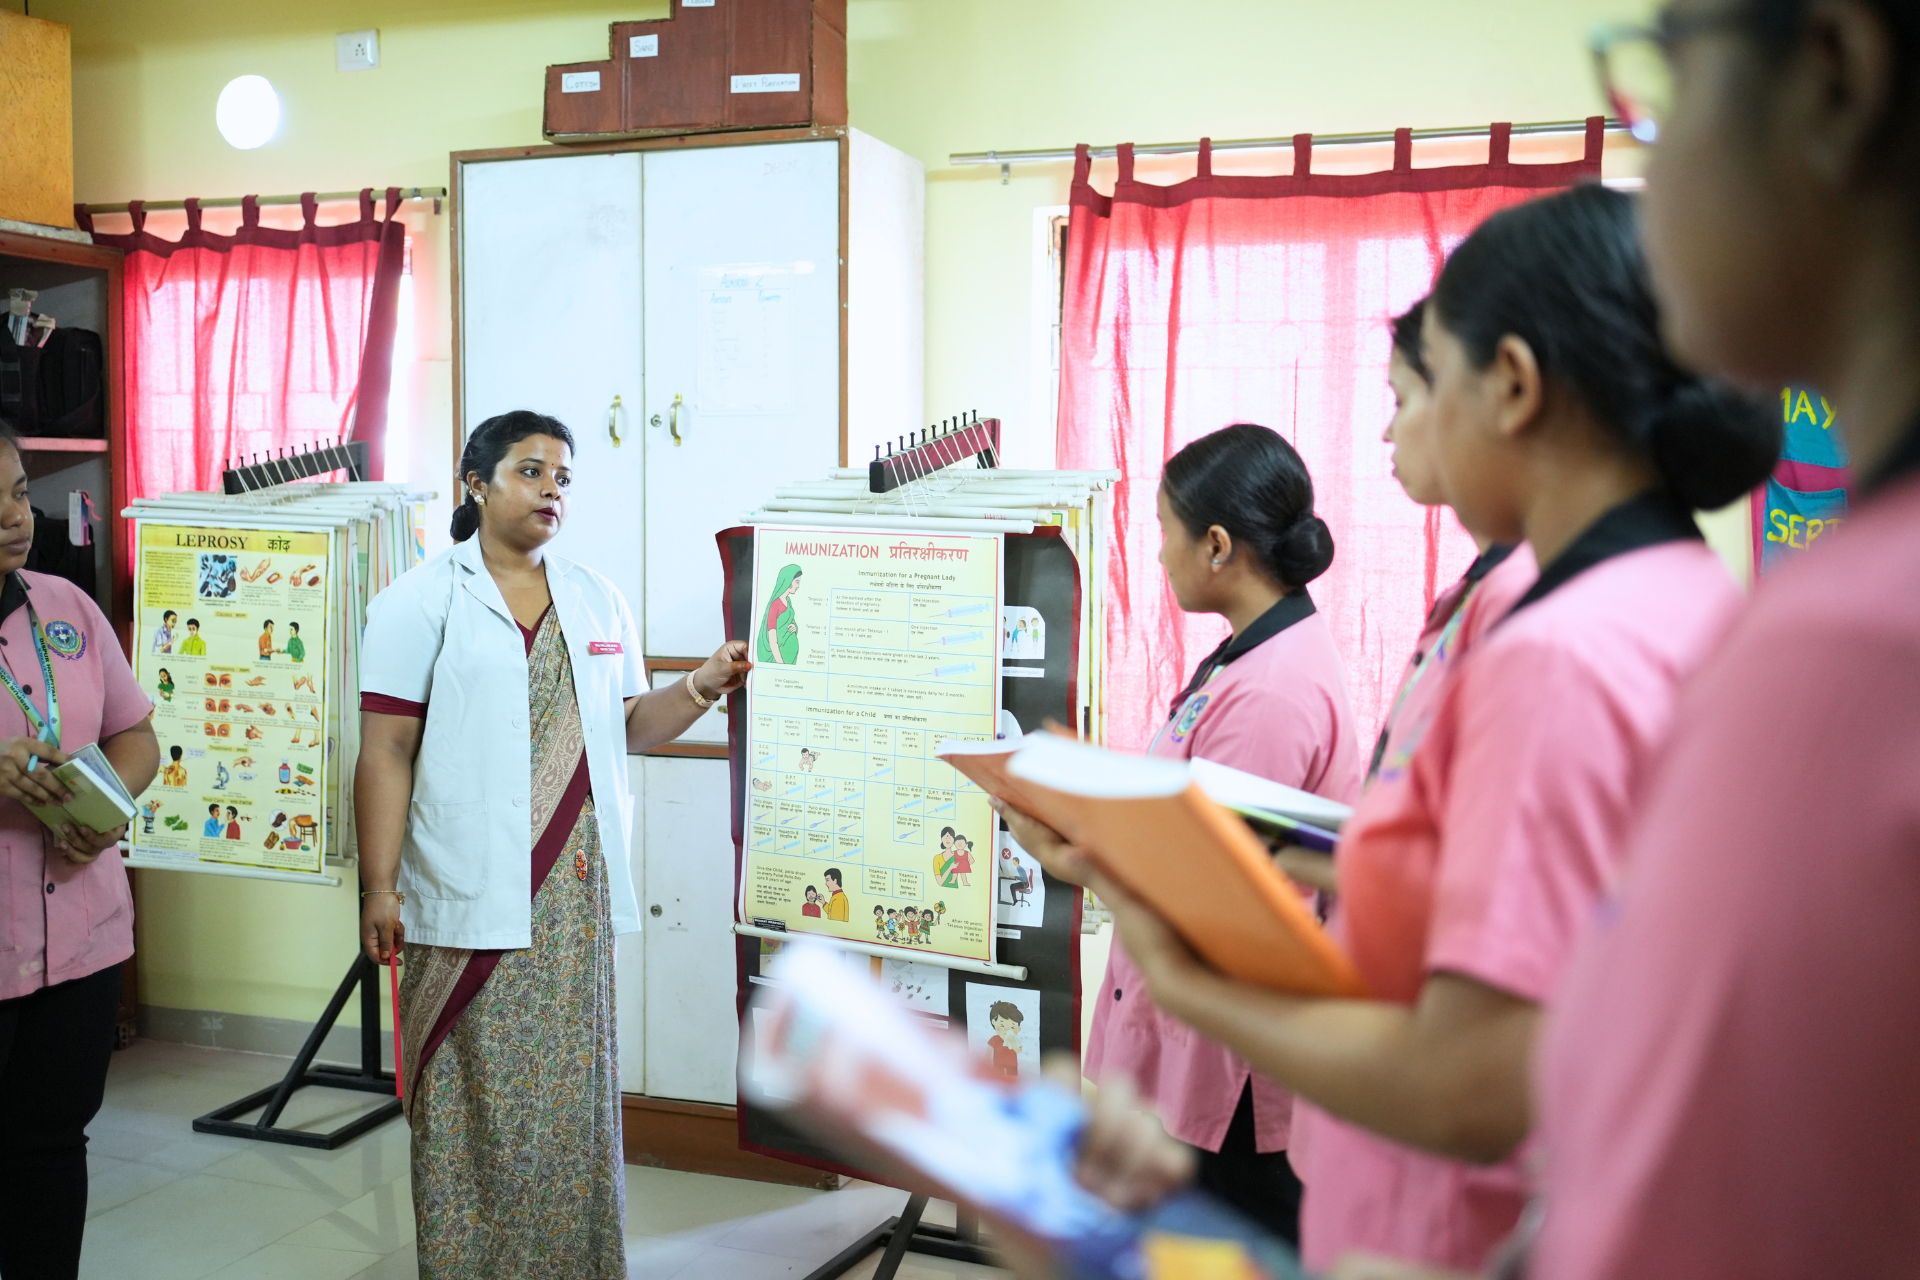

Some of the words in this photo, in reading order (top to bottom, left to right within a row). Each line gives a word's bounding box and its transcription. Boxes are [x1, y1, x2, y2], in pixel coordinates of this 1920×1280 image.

[175, 533, 248, 550] LEPROSY
[785, 541, 879, 559] IMMUNIZATION
[888, 541, 970, 563] प्रतिरक्षीकरण
[858, 570, 897, 578] Immunization
[914, 573, 940, 582] Pregnant
[941, 575, 956, 583] Lady
[39, 638, 50, 663] DISPUR
[46, 664, 57, 703] HOSPITALS
[806, 706, 845, 716] Immunization
[846, 708, 855, 717] for
[860, 709, 877, 719] Child
